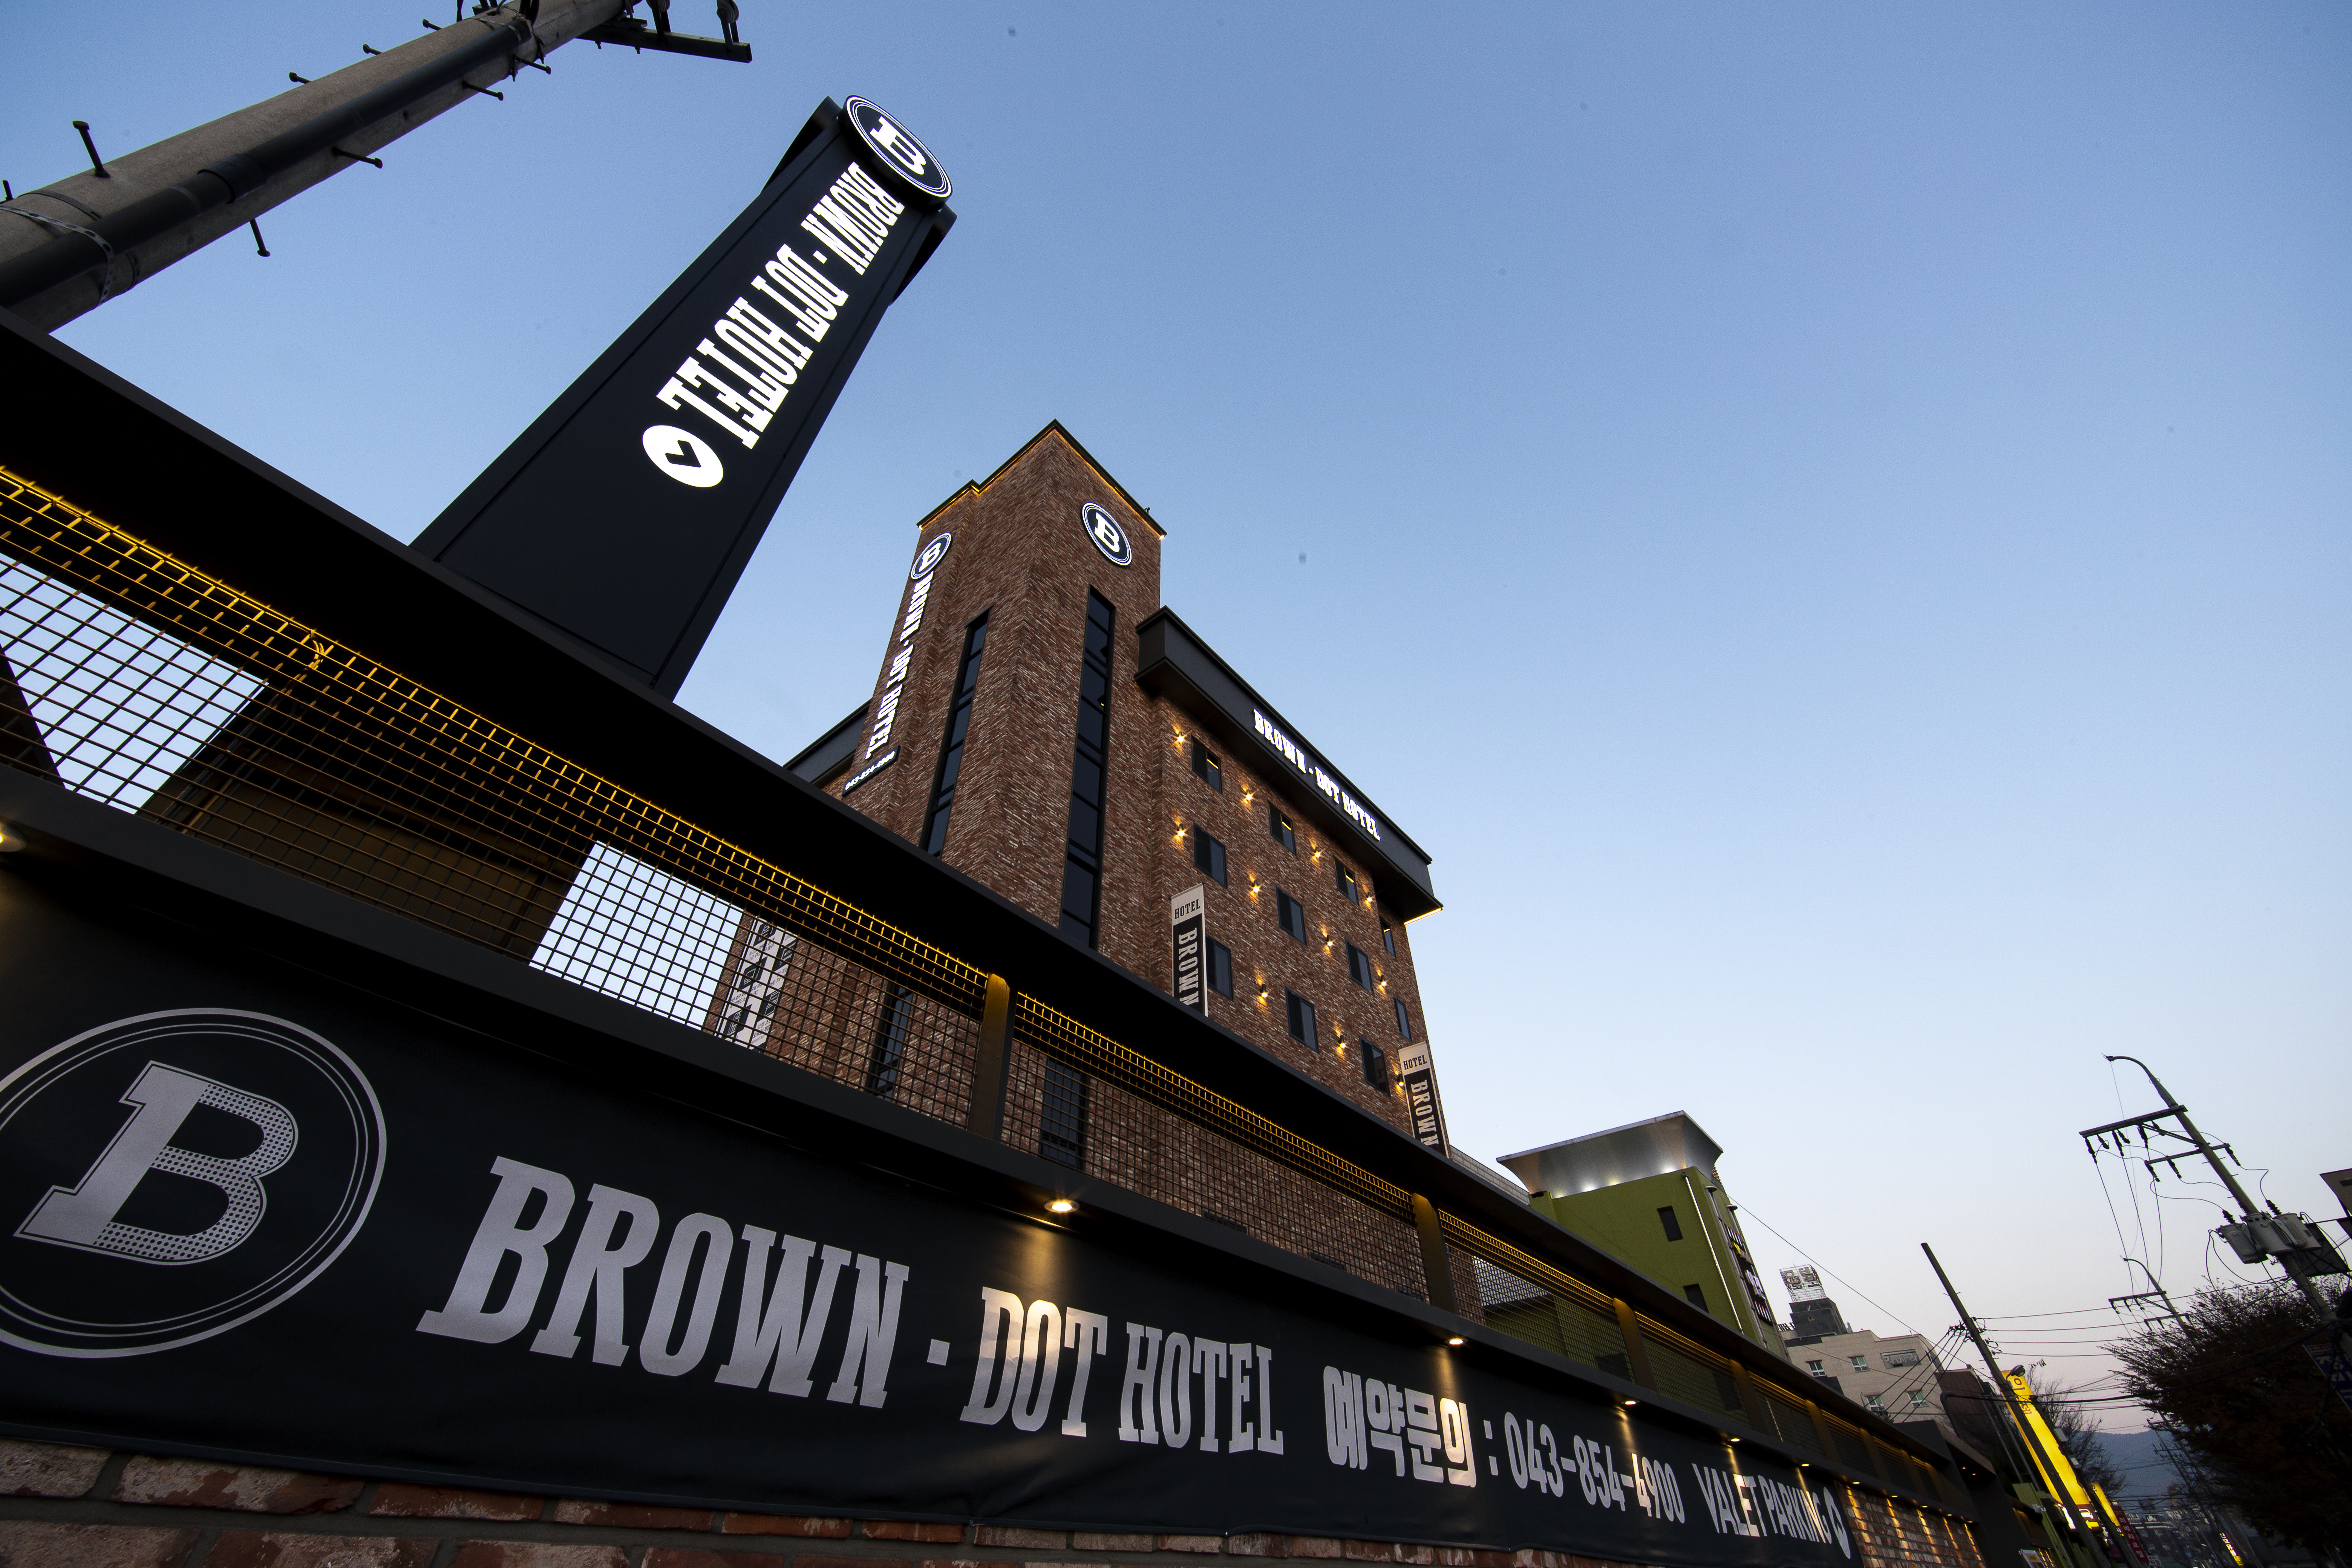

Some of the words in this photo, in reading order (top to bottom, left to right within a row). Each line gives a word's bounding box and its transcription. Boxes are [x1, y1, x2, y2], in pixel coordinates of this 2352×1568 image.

[870, 116, 926, 175] B
[801, 161, 905, 276] BROWN
[751, 243, 849, 343] DOT
[656, 296, 813, 449] HOTEL
[919, 543, 940, 573] B
[1094, 512, 1120, 552] B
[900, 571, 934, 642] BROWN
[886, 644, 914, 688] DOT
[865, 683, 903, 760] HOTEL
[1253, 709, 1306, 773] BROWN
[1315, 766, 1340, 804] DOT
[1341, 791, 1381, 841] HOTEL
[1174, 899, 1200, 919] HOTEL
[1403, 1055, 1427, 1070] HOTEL
[13, 1060, 299, 1265] B
[415, 1156, 910, 1409] BROWN
[960, 1286, 1108, 1437] DOT
[1118, 1321, 1283, 1455] HOTEL
[1323, 1366, 1476, 1488] 예약문의
[1504, 1412, 1685, 1524] 043-854-4900
[1692, 1463, 1767, 1537] VALET
[1758, 1475, 1832, 1544] PARKING
